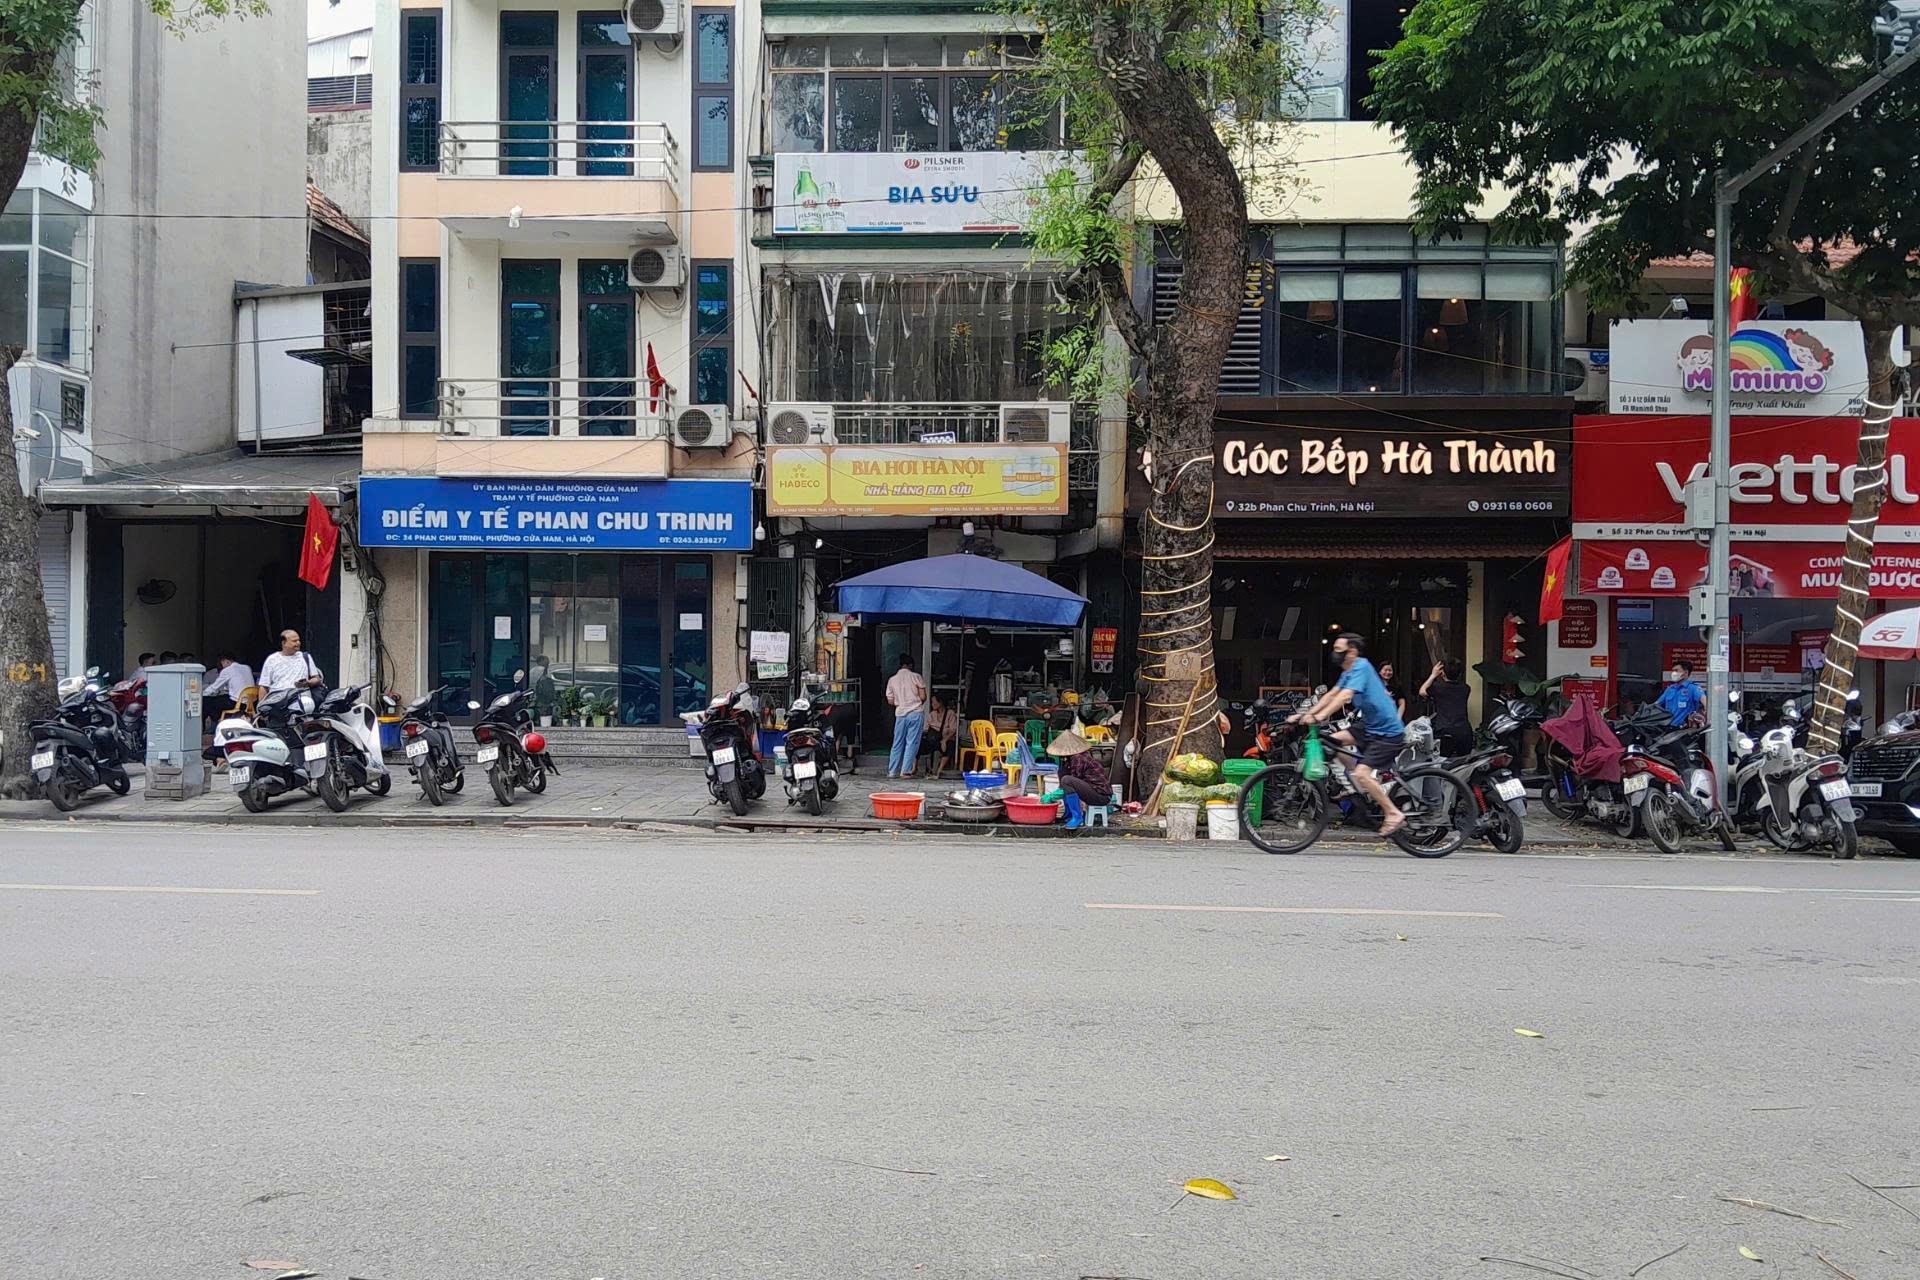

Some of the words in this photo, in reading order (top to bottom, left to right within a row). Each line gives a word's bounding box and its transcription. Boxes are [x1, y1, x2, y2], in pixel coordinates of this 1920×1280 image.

[888, 186, 924, 204] BIA
[1686, 366, 1824, 390] Mmimo
[852, 460, 881, 476] BIA
[922, 456, 949, 475] HÀ
[951, 456, 984, 478] NỘI
[1223, 440, 1288, 477] Góc
[1301, 437, 1369, 486] Bếp
[1381, 440, 1433, 475] Hà
[1443, 440, 1556, 474] Thành
[779, 480, 820, 488] HABECO
[1656, 452, 1919, 504] vettl
[507, 484, 532, 492] NHÂN
[892, 482, 924, 496] HÀNG
[926, 484, 946, 496] BIA
[1238, 502, 1257, 512] 32b
[1260, 502, 1285, 512] Phan
[1286, 502, 1307, 512] Chu
[1310, 502, 1338, 513] Trinh,
[1340, 502, 1354, 512] Hà
[1356, 502, 1374, 513] Nội
[1482, 502, 1507, 511] 0931
[1509, 502, 1522, 511] 68
[1524, 502, 1553, 511] 0608
[382, 503, 448, 528] ĐIỂM
[456, 510, 472, 528] Y
[480, 505, 511, 529] TẾ
[518, 511, 588, 530] PHAN
[597, 512, 649, 530] CHU
[656, 512, 733, 531] TRINH
[1635, 528, 1654, 536] Phan
[1656, 528, 1670, 536] Chu
[1672, 528, 1691, 536] Trinh
[1754, 529, 1767, 537] Nội
[566, 534, 578, 543] HÀ
[1872, 630, 1904, 642] 5G
